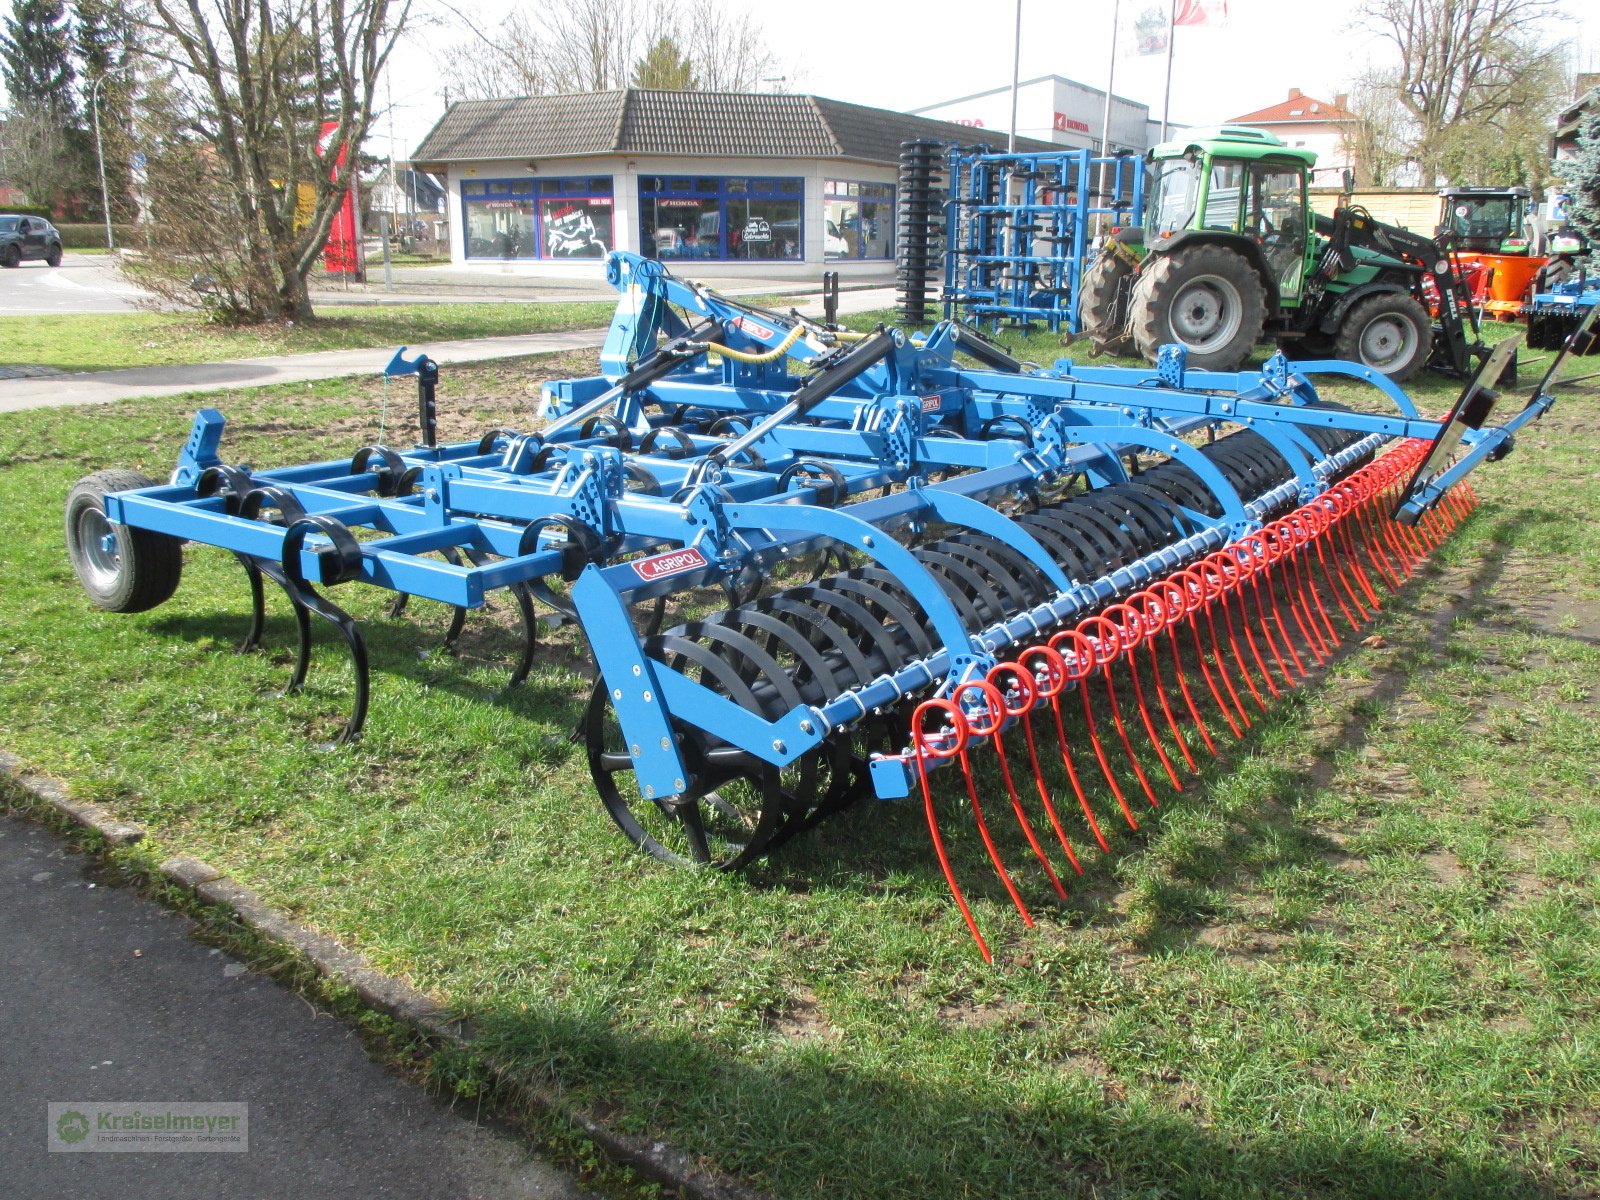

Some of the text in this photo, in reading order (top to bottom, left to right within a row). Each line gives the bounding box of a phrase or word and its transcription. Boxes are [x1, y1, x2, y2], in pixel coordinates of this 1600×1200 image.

[1067, 119, 1089, 132] HONDA
[922, 398, 939, 409] GRIPOL
[652, 552, 701, 573] AGRIPOL
